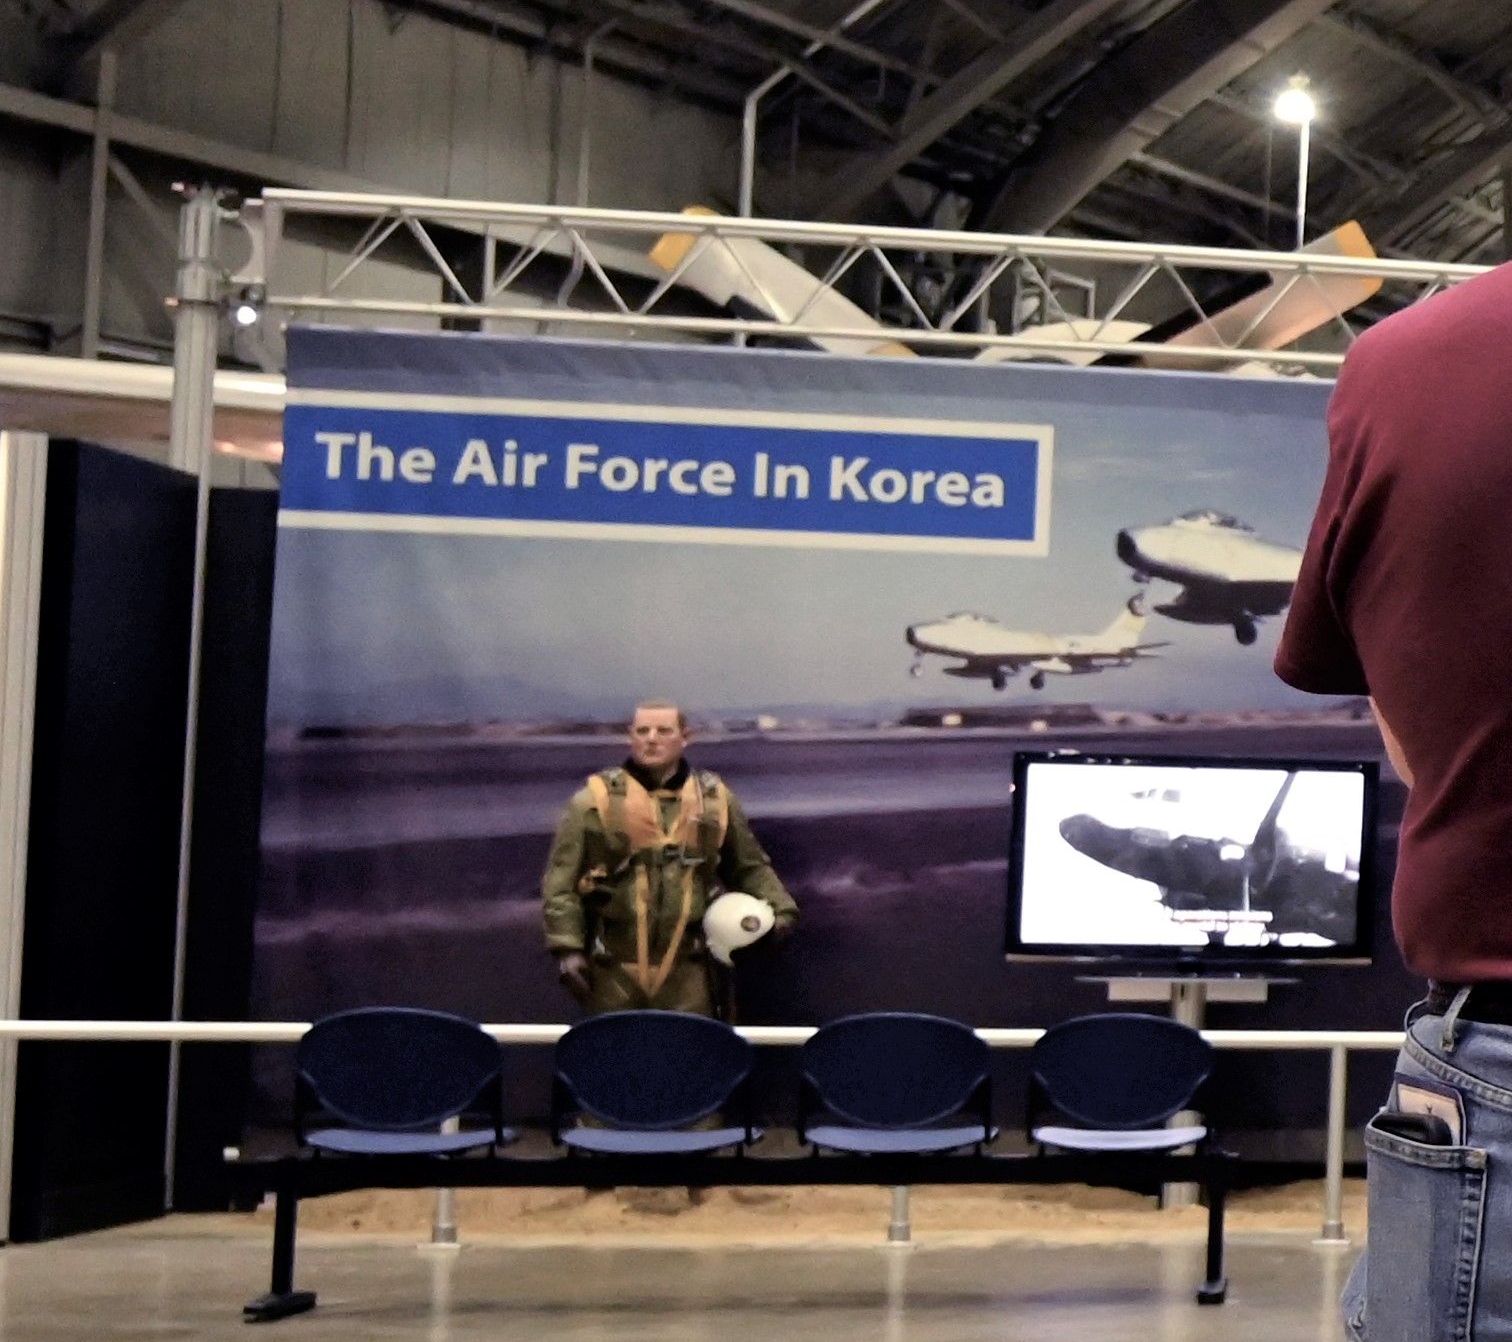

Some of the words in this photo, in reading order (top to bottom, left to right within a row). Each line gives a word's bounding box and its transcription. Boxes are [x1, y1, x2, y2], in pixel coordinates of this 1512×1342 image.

[315, 431, 436, 483] The
[452, 439, 548, 487] Air
[565, 443, 737, 497] Force
[753, 452, 811, 499] In
[830, 456, 1006, 508] Korea
